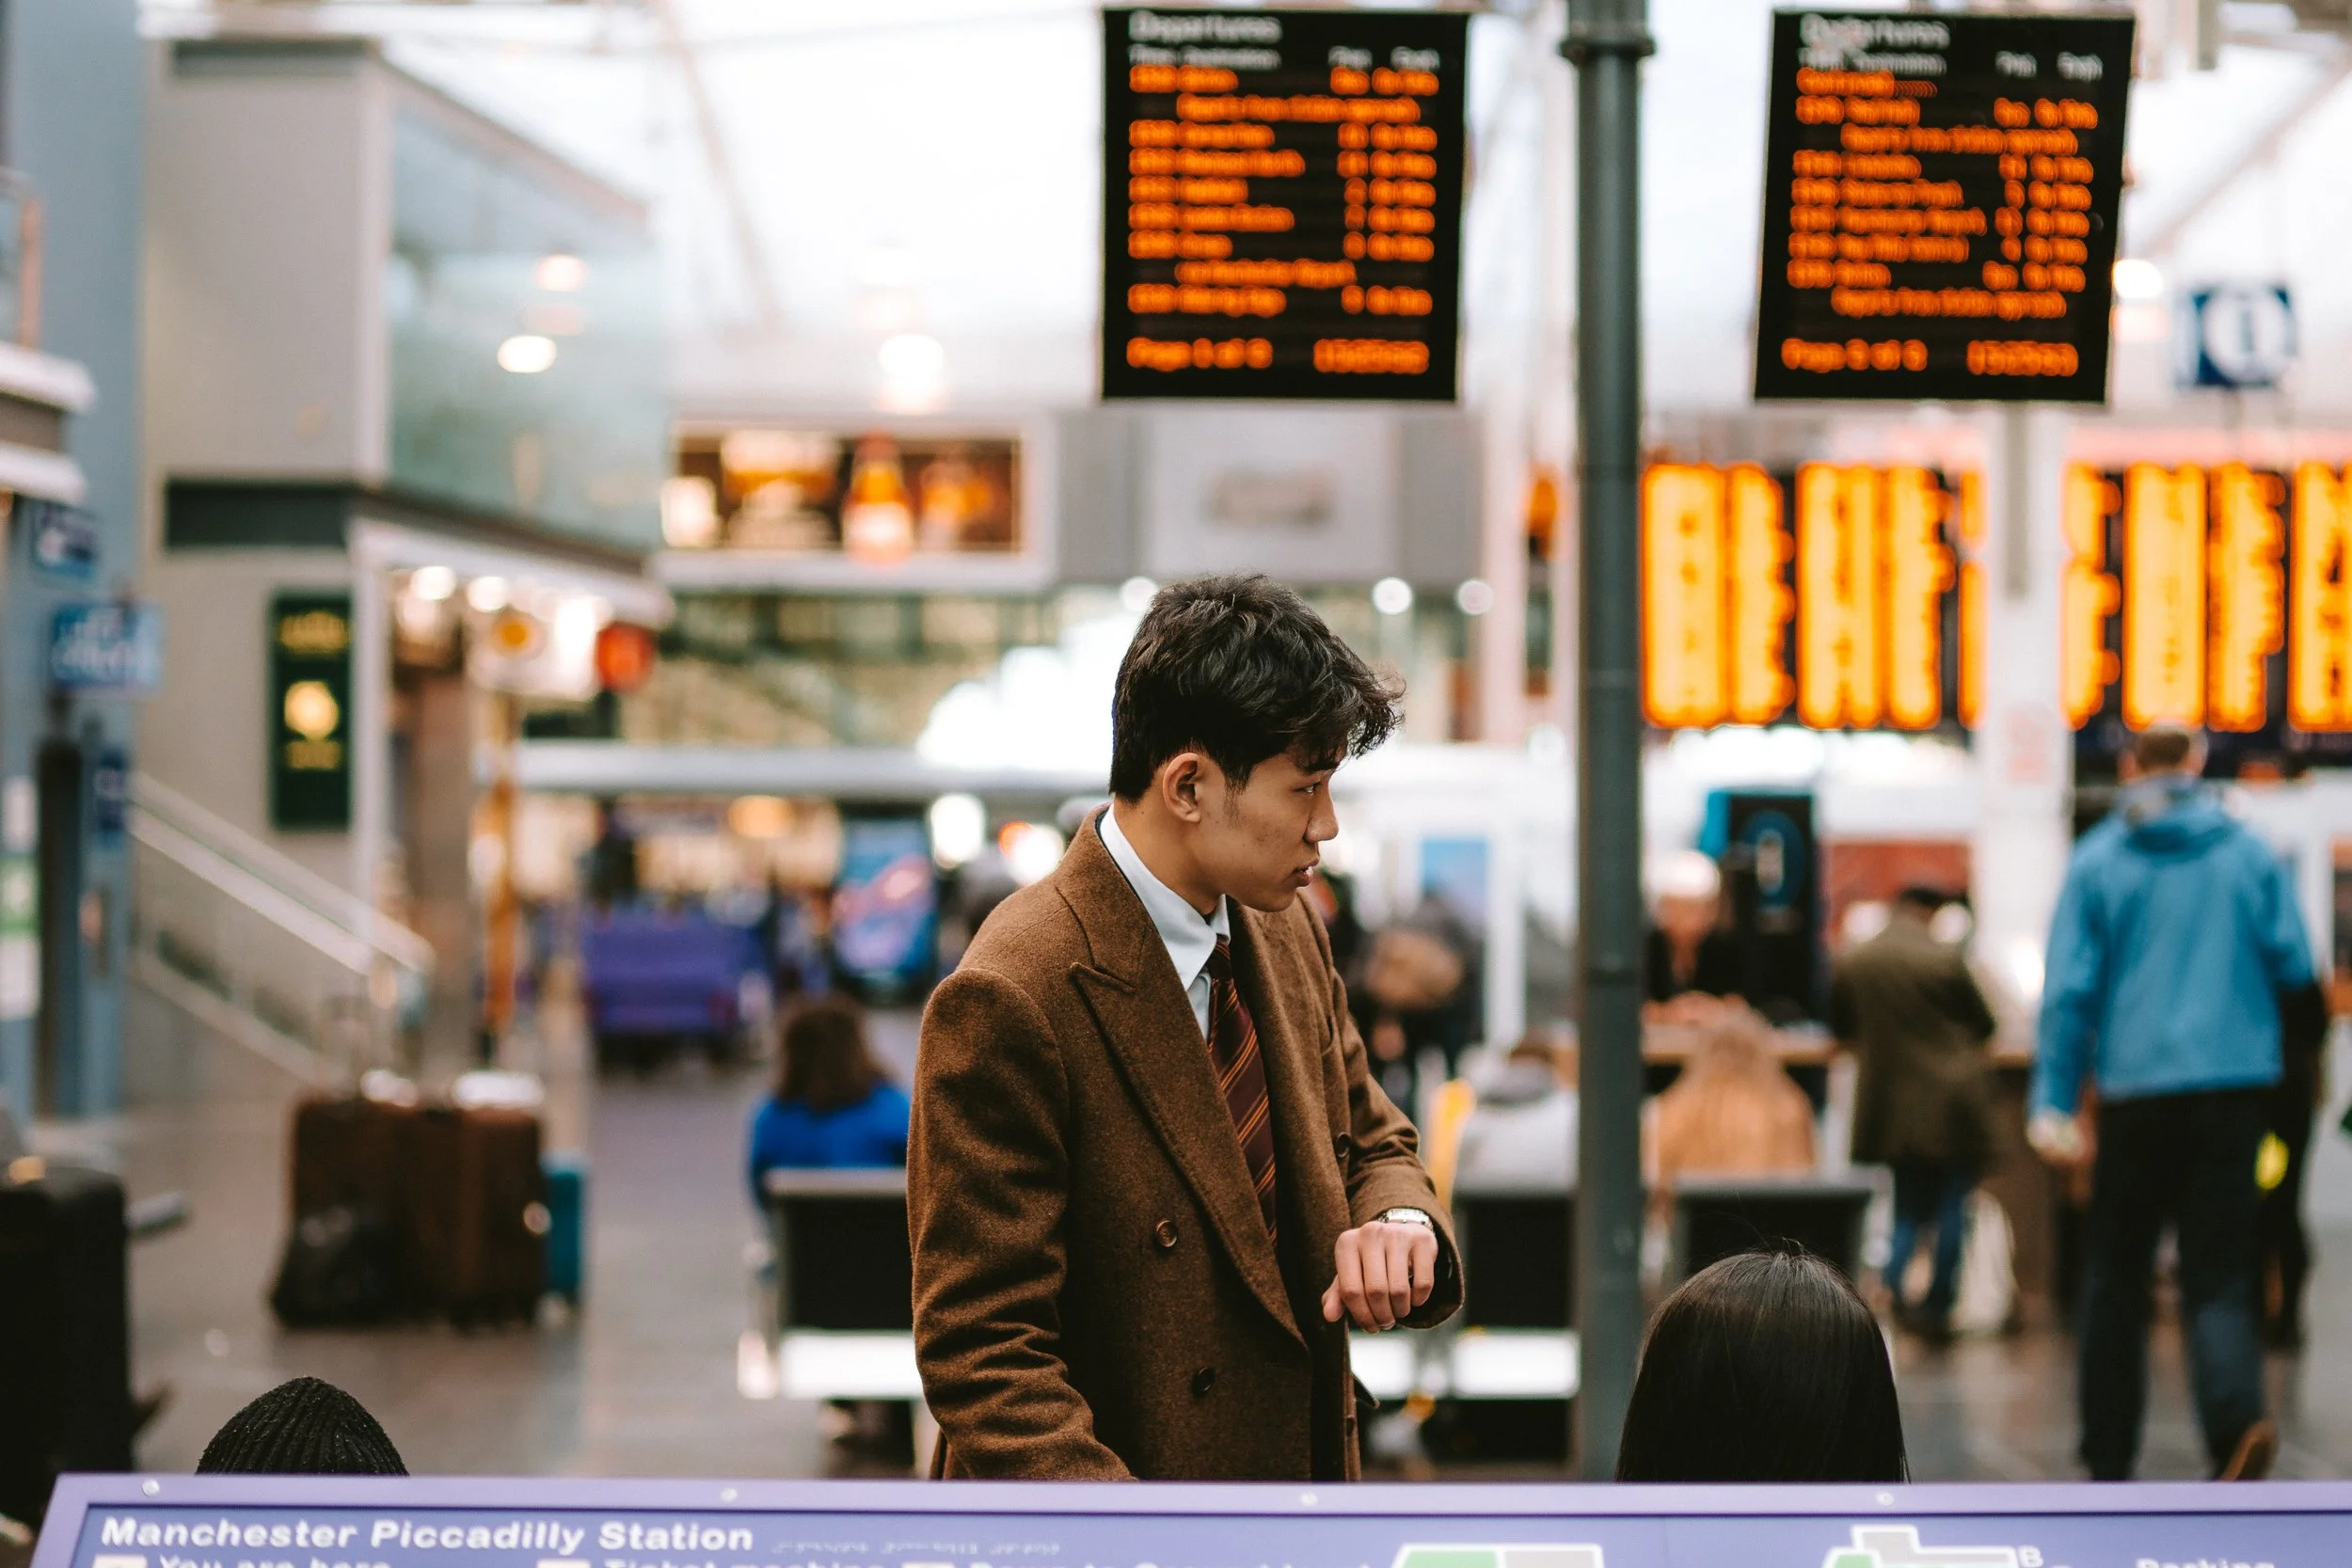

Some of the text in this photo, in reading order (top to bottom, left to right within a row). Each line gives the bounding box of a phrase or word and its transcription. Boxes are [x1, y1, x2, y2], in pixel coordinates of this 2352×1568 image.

[101, 1516, 358, 1548] Manchester
[371, 1519, 585, 1555] Piccadilly
[598, 1520, 754, 1551] Station
